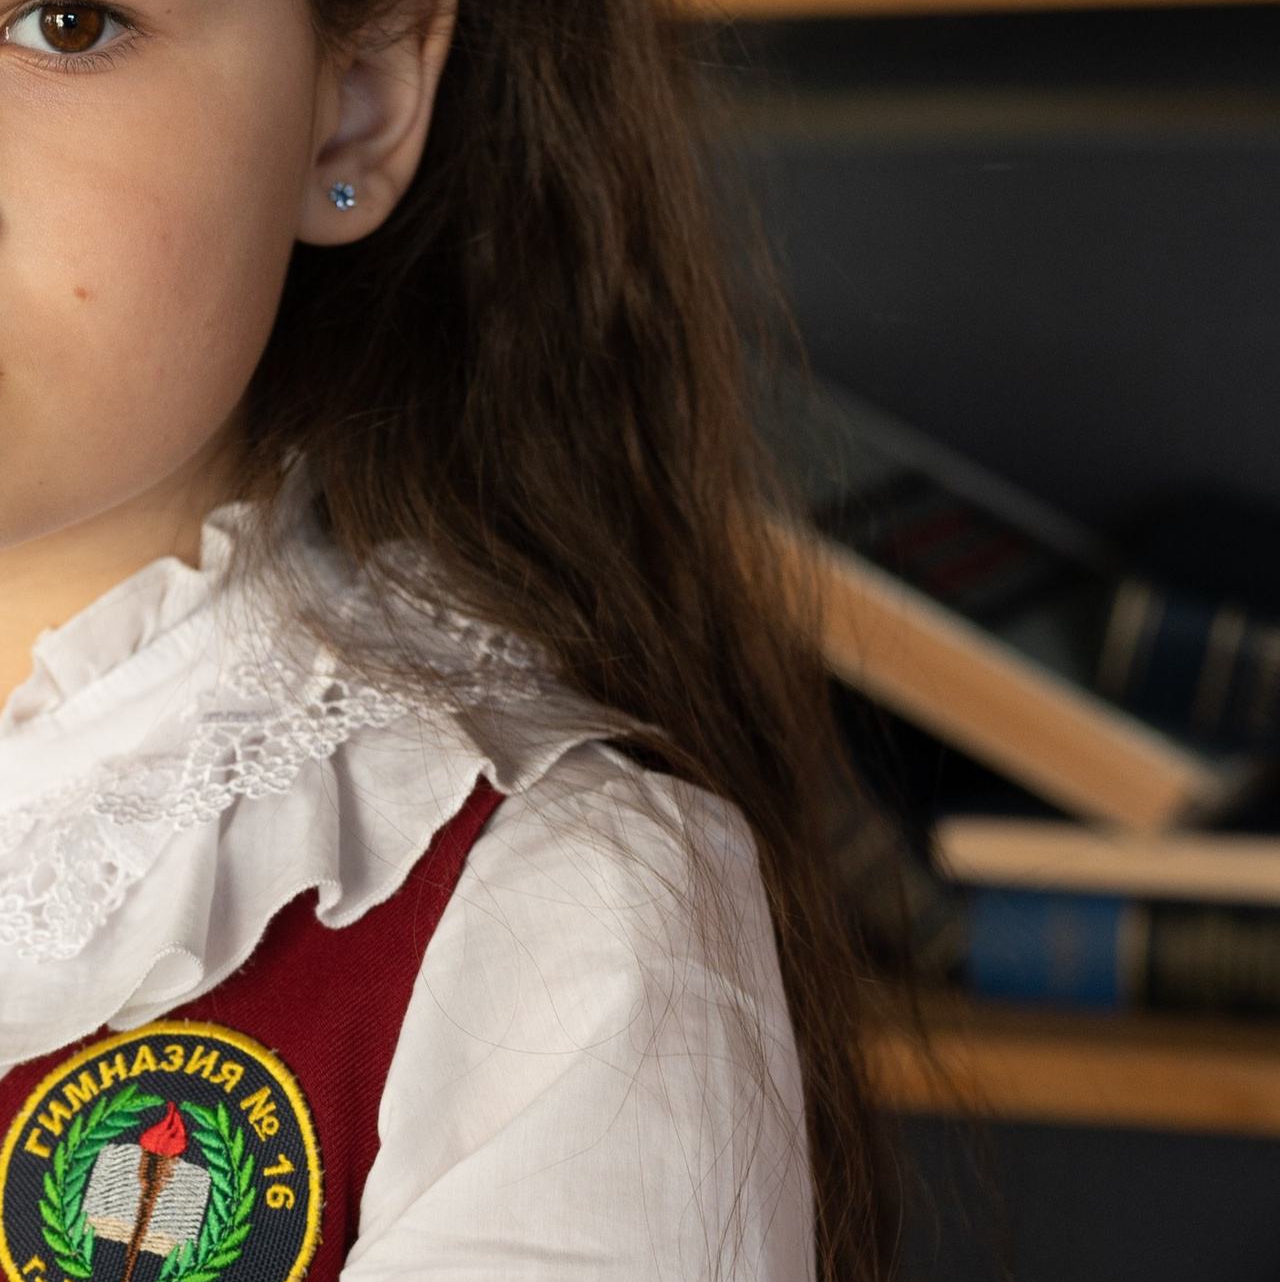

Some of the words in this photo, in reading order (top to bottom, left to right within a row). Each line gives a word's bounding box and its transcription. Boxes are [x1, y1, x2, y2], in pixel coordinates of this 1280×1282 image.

[24, 1044, 244, 1158] ГИМНАЗИЯ
[240, 1088, 280, 1142] №
[263, 1153, 296, 1210] 16
